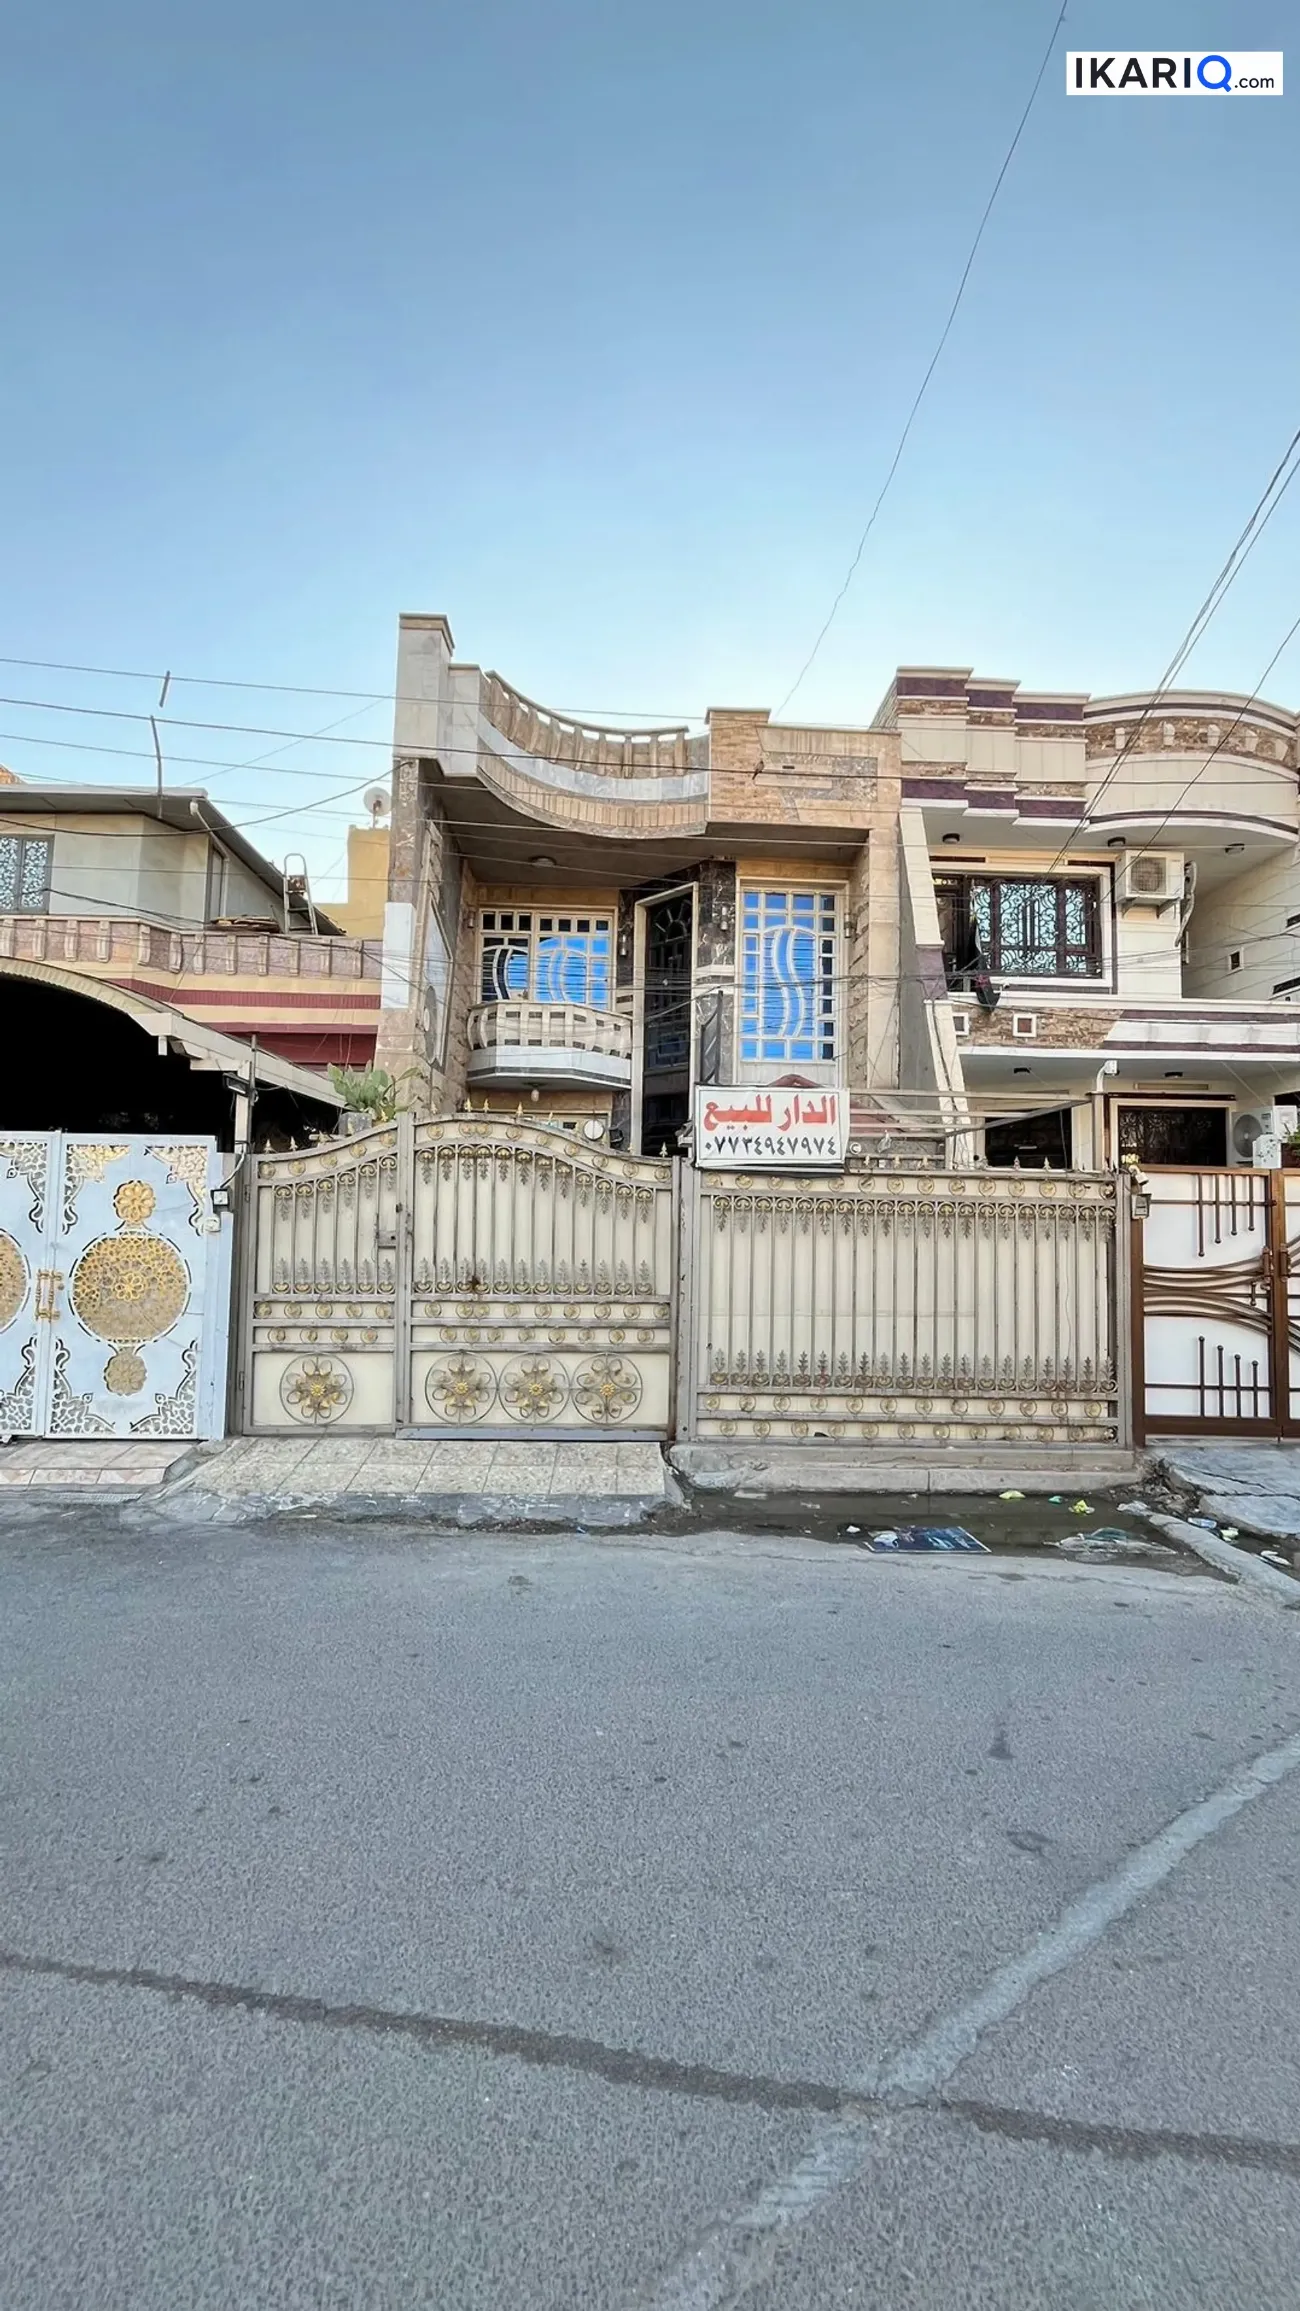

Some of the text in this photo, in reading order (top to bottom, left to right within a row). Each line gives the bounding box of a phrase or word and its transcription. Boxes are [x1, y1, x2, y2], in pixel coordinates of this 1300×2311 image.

[703, 1095, 836, 1131] الدار للبيع
[705, 1136, 836, 1156] ٠٧٧٣٤٩٤٧٩٧٤
